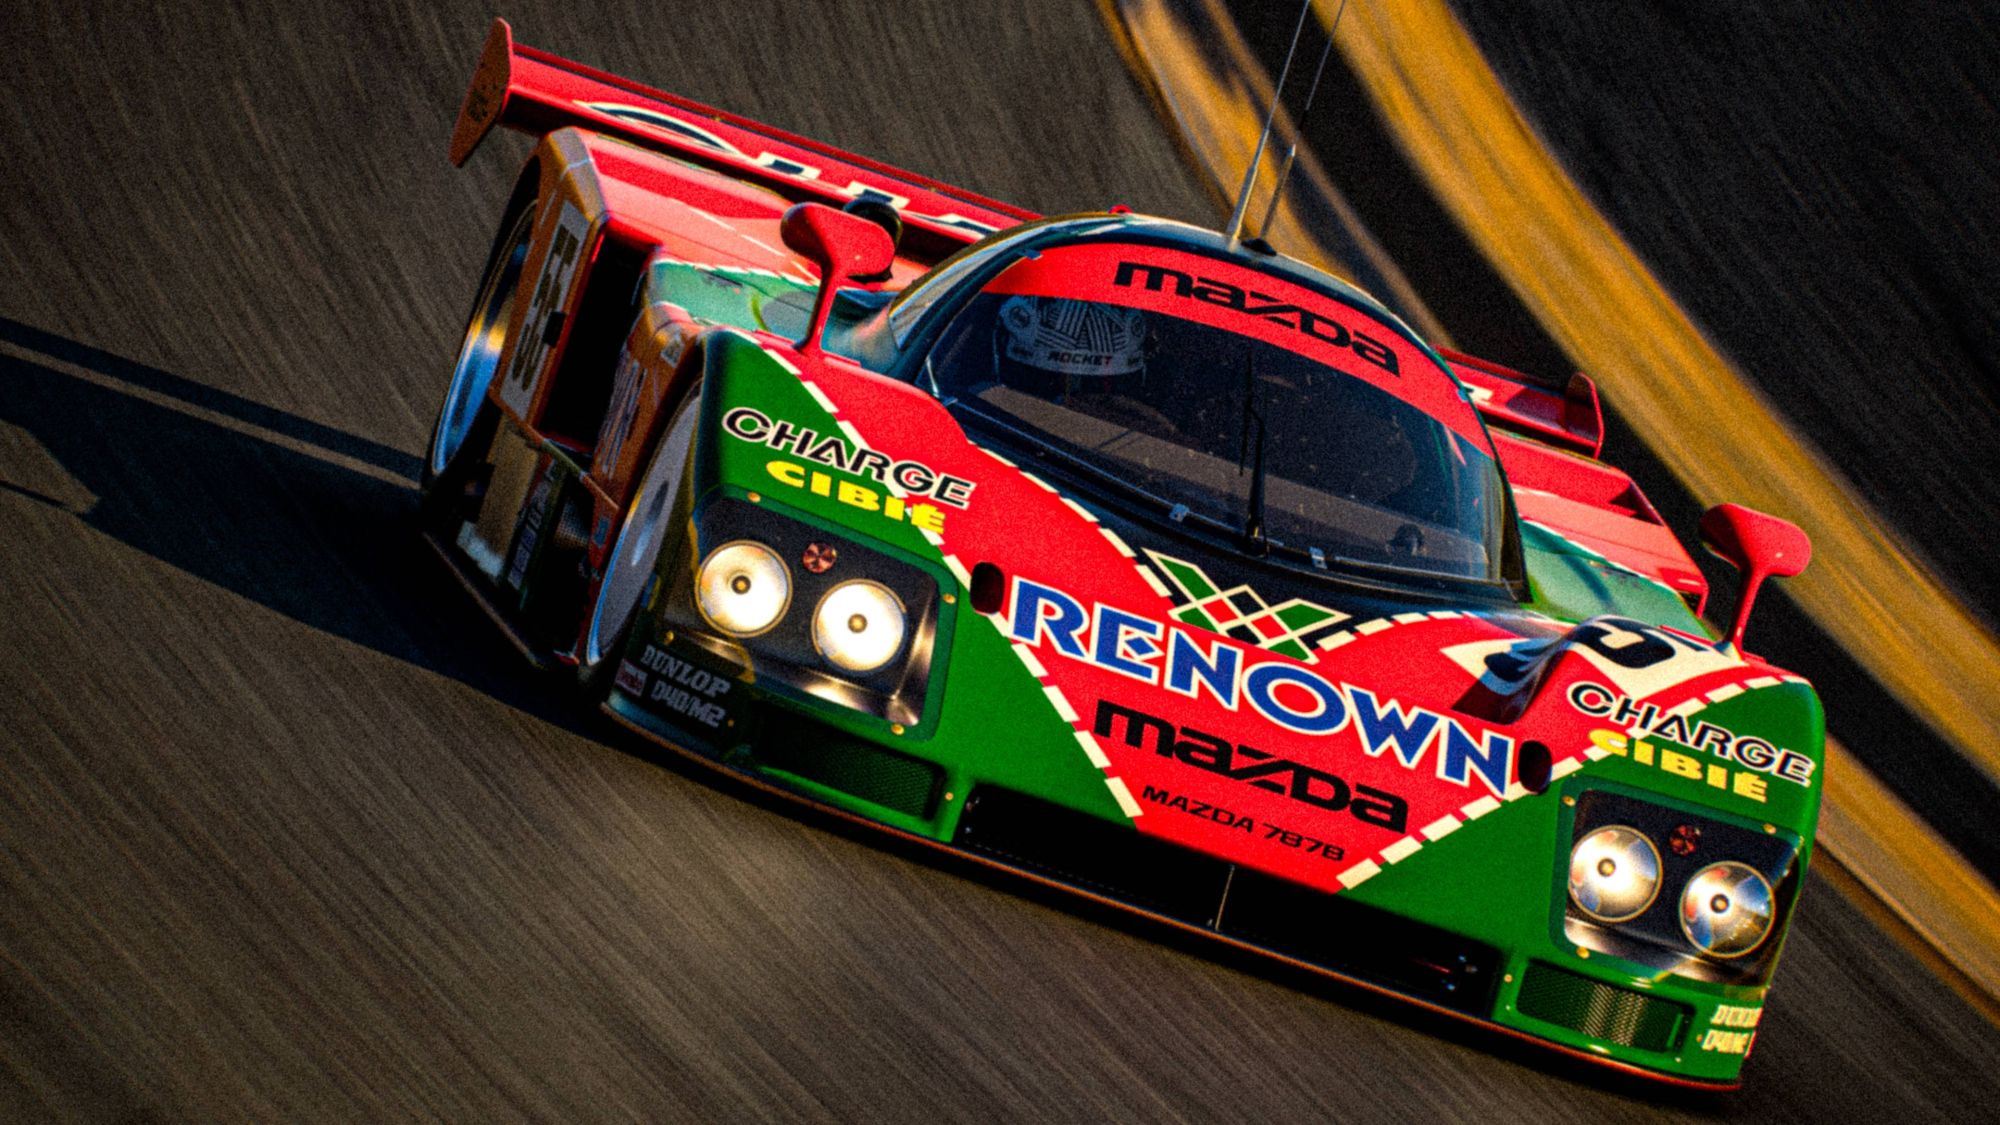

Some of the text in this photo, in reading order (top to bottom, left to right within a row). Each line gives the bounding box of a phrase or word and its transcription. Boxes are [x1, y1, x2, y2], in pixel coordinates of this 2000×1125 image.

[722, 407, 976, 510] CHARGE
[640, 644, 731, 698] DUNLOP
[1010, 575, 1515, 798] RENOWN
[1566, 681, 1815, 788] CHARGE
[1142, 785, 1345, 862] MAZDA 787B
